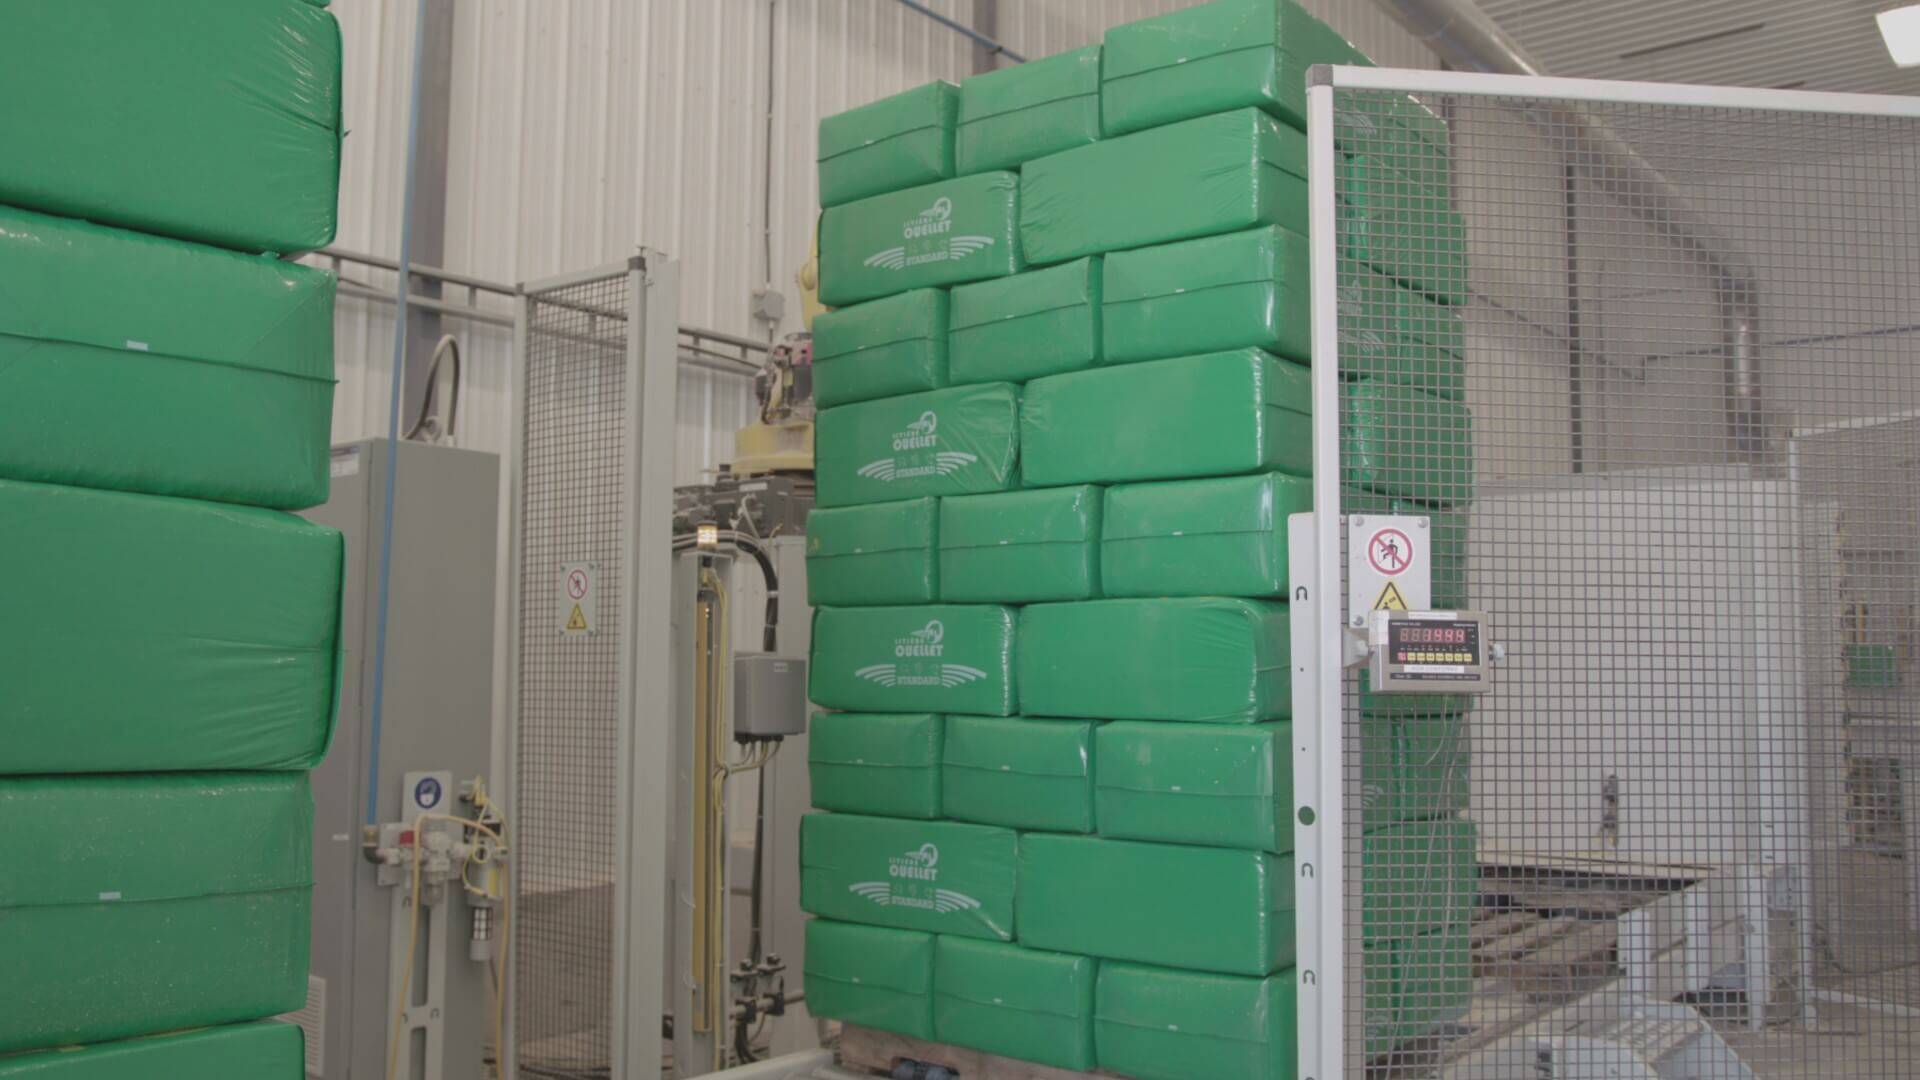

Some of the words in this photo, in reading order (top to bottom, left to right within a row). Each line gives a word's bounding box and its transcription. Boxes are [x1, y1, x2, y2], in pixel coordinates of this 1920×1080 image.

[903, 220, 951, 239] OUELLET
[905, 251, 949, 266] STANDARD
[892, 435, 937, 451] OUELLET
[895, 644, 943, 657] OUELLET
[896, 676, 941, 685] STANDARD
[889, 864, 938, 881] OUELLET
[891, 895, 935, 909] STANDARD
